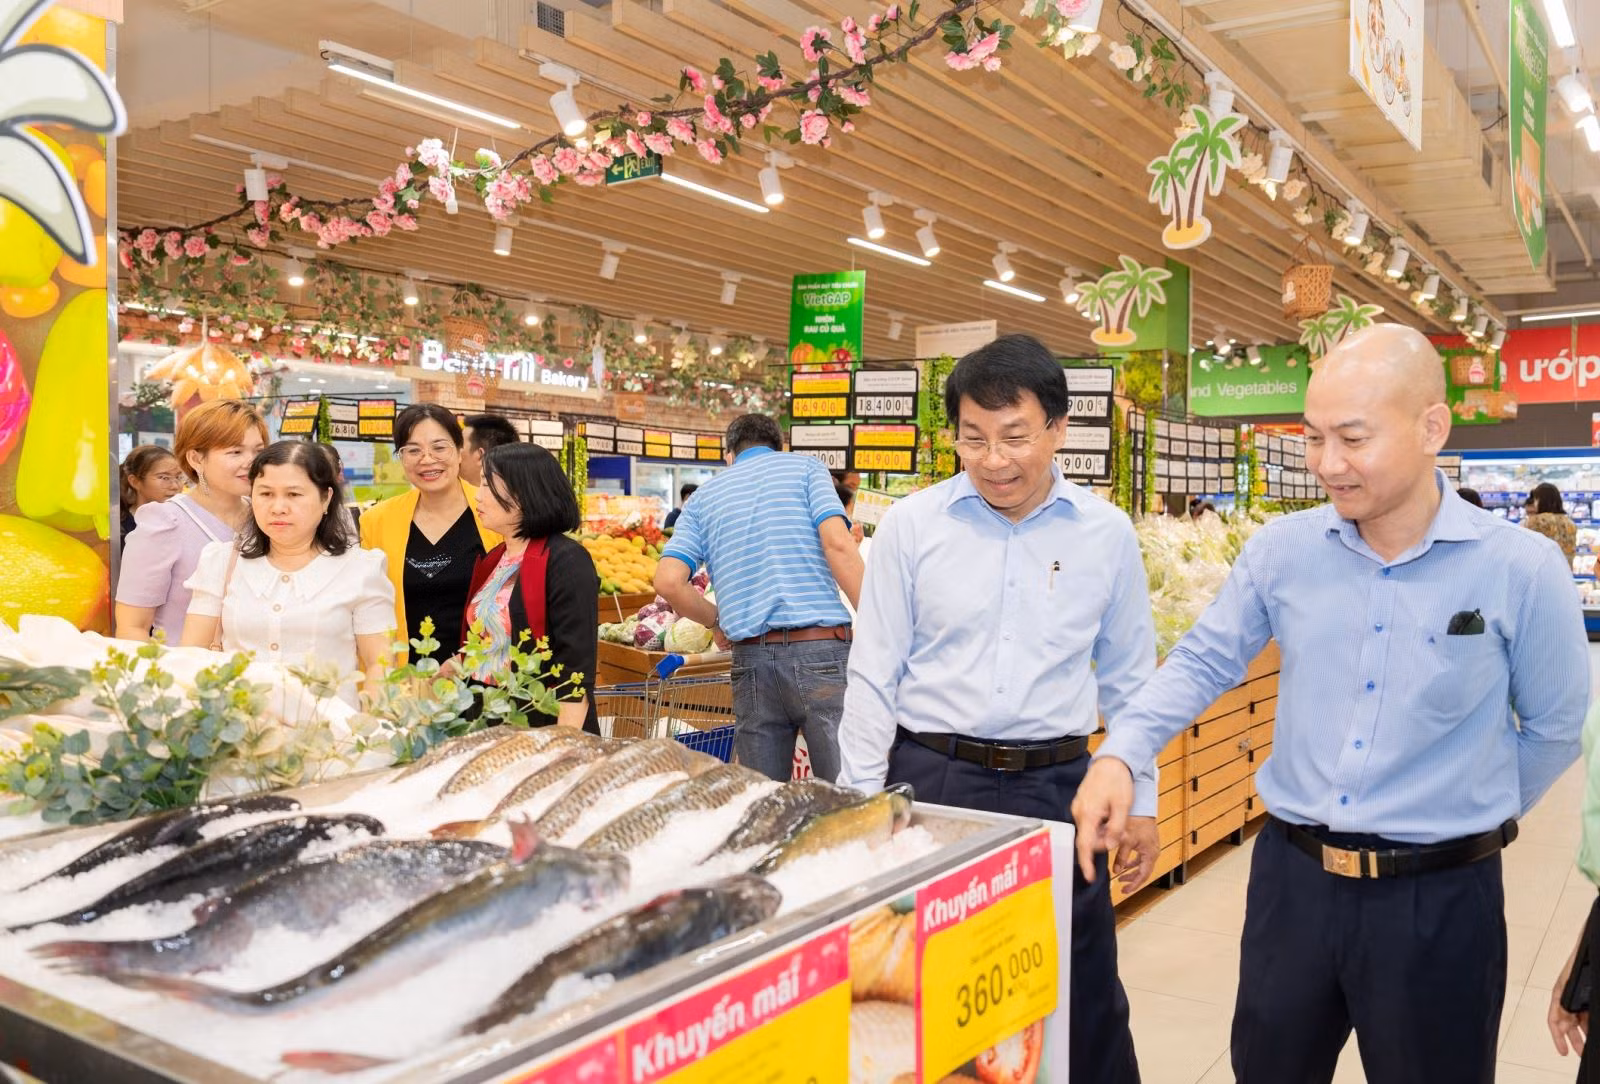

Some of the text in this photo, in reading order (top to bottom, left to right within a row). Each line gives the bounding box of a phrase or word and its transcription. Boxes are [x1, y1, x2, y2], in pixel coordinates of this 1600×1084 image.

[803, 292, 850, 305] VietGAP
[541, 368, 589, 392] Bakery
[1519, 349, 1600, 387] ướp
[1217, 380, 1297, 399] Vegetables
[923, 876, 987, 932] Khuyến
[632, 995, 745, 1084] Khuyến
